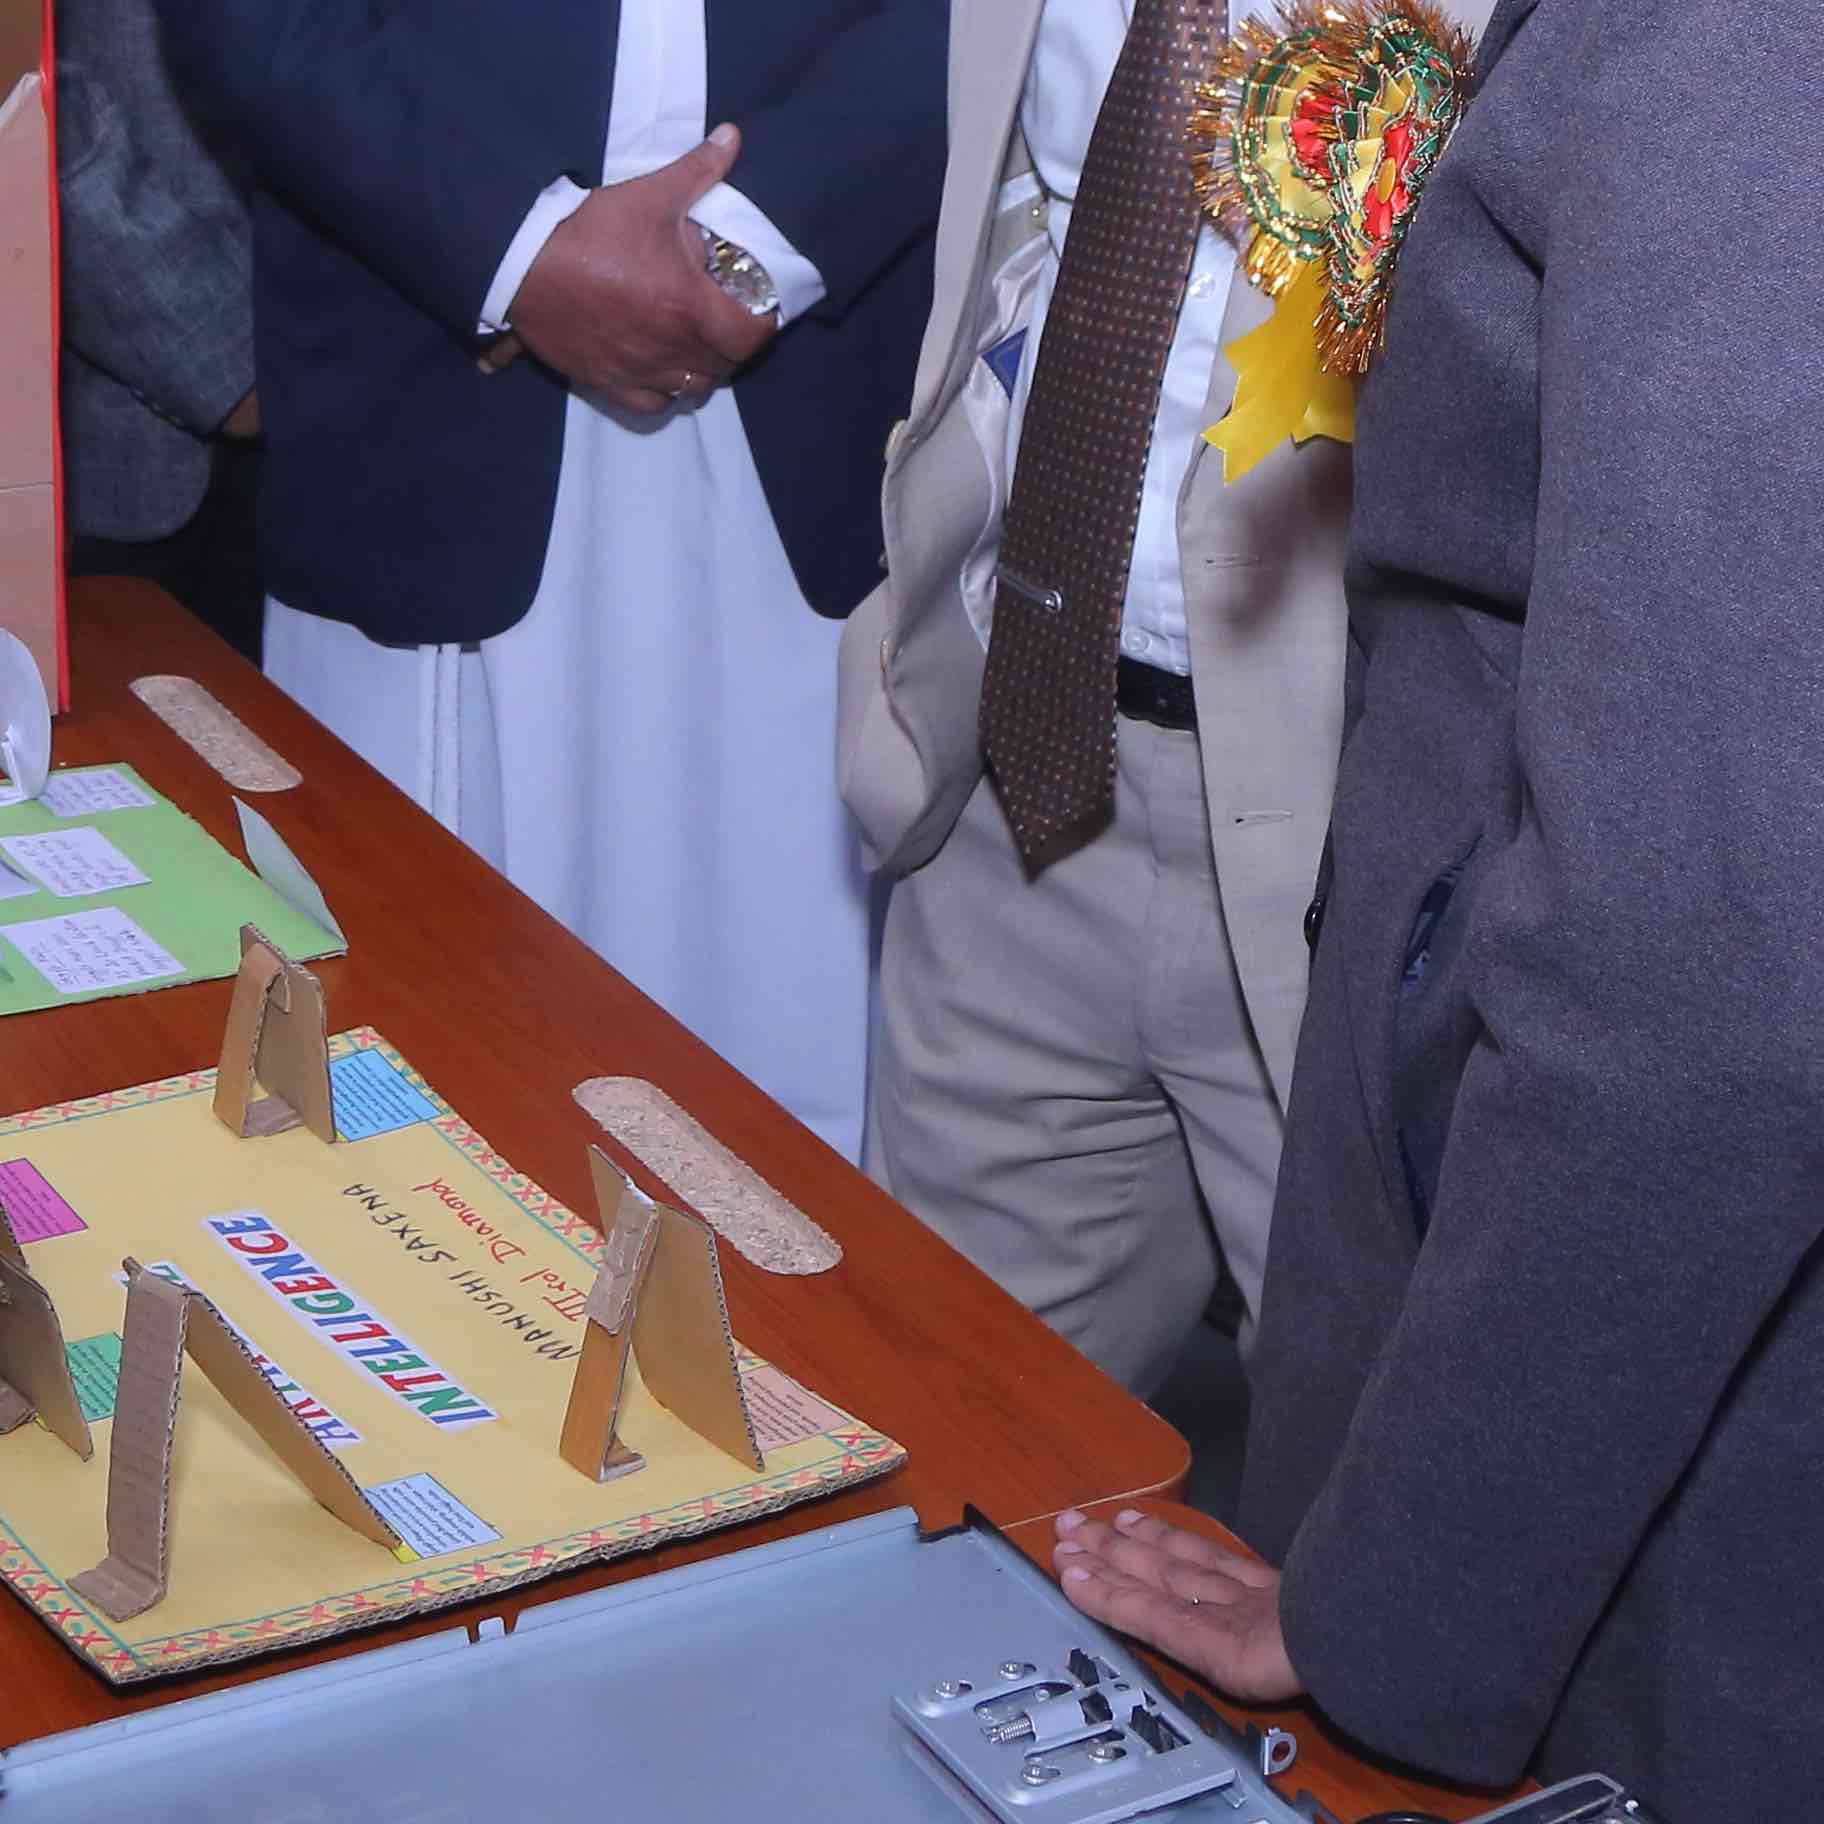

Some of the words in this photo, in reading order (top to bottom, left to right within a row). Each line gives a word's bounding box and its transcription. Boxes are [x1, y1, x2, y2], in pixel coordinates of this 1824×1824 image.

[342, 1183, 458, 1264] SAXENA
[411, 1177, 527, 1265] Diamond
[208, 1215, 496, 1425] INTELLIGENCE
[449, 1270, 583, 1361] MANUSHI
